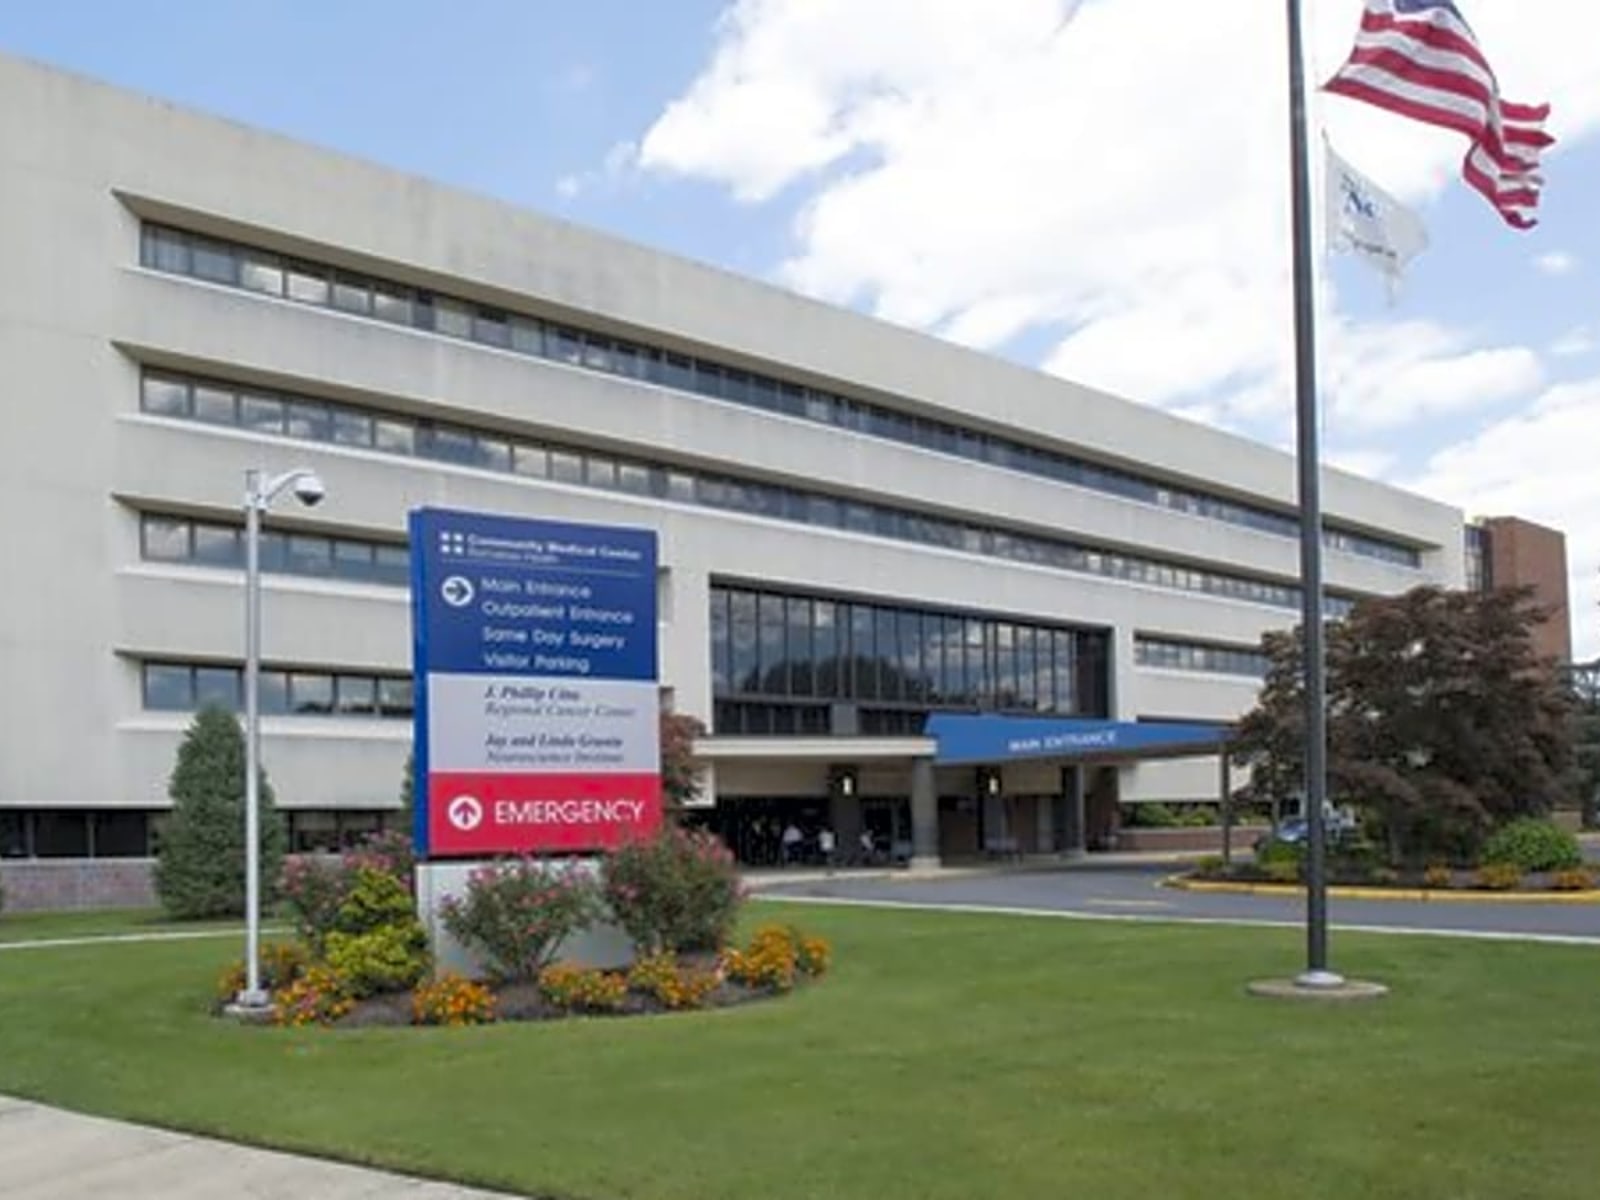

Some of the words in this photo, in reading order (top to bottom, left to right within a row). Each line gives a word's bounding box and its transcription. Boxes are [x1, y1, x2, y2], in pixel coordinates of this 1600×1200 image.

[481, 577, 521, 593] Main
[525, 580, 592, 599] Entrance
[481, 601, 565, 619] Outpatient
[569, 605, 634, 623] Entrance
[482, 626, 528, 643] Same
[532, 628, 565, 646] Day
[569, 630, 626, 649] Surgery
[483, 652, 531, 668] Visitor
[534, 655, 591, 673] Parking
[1008, 737, 1041, 751] MAIN
[1043, 730, 1117, 749] ENTRANCE
[494, 800, 646, 824] EMERGENCY
